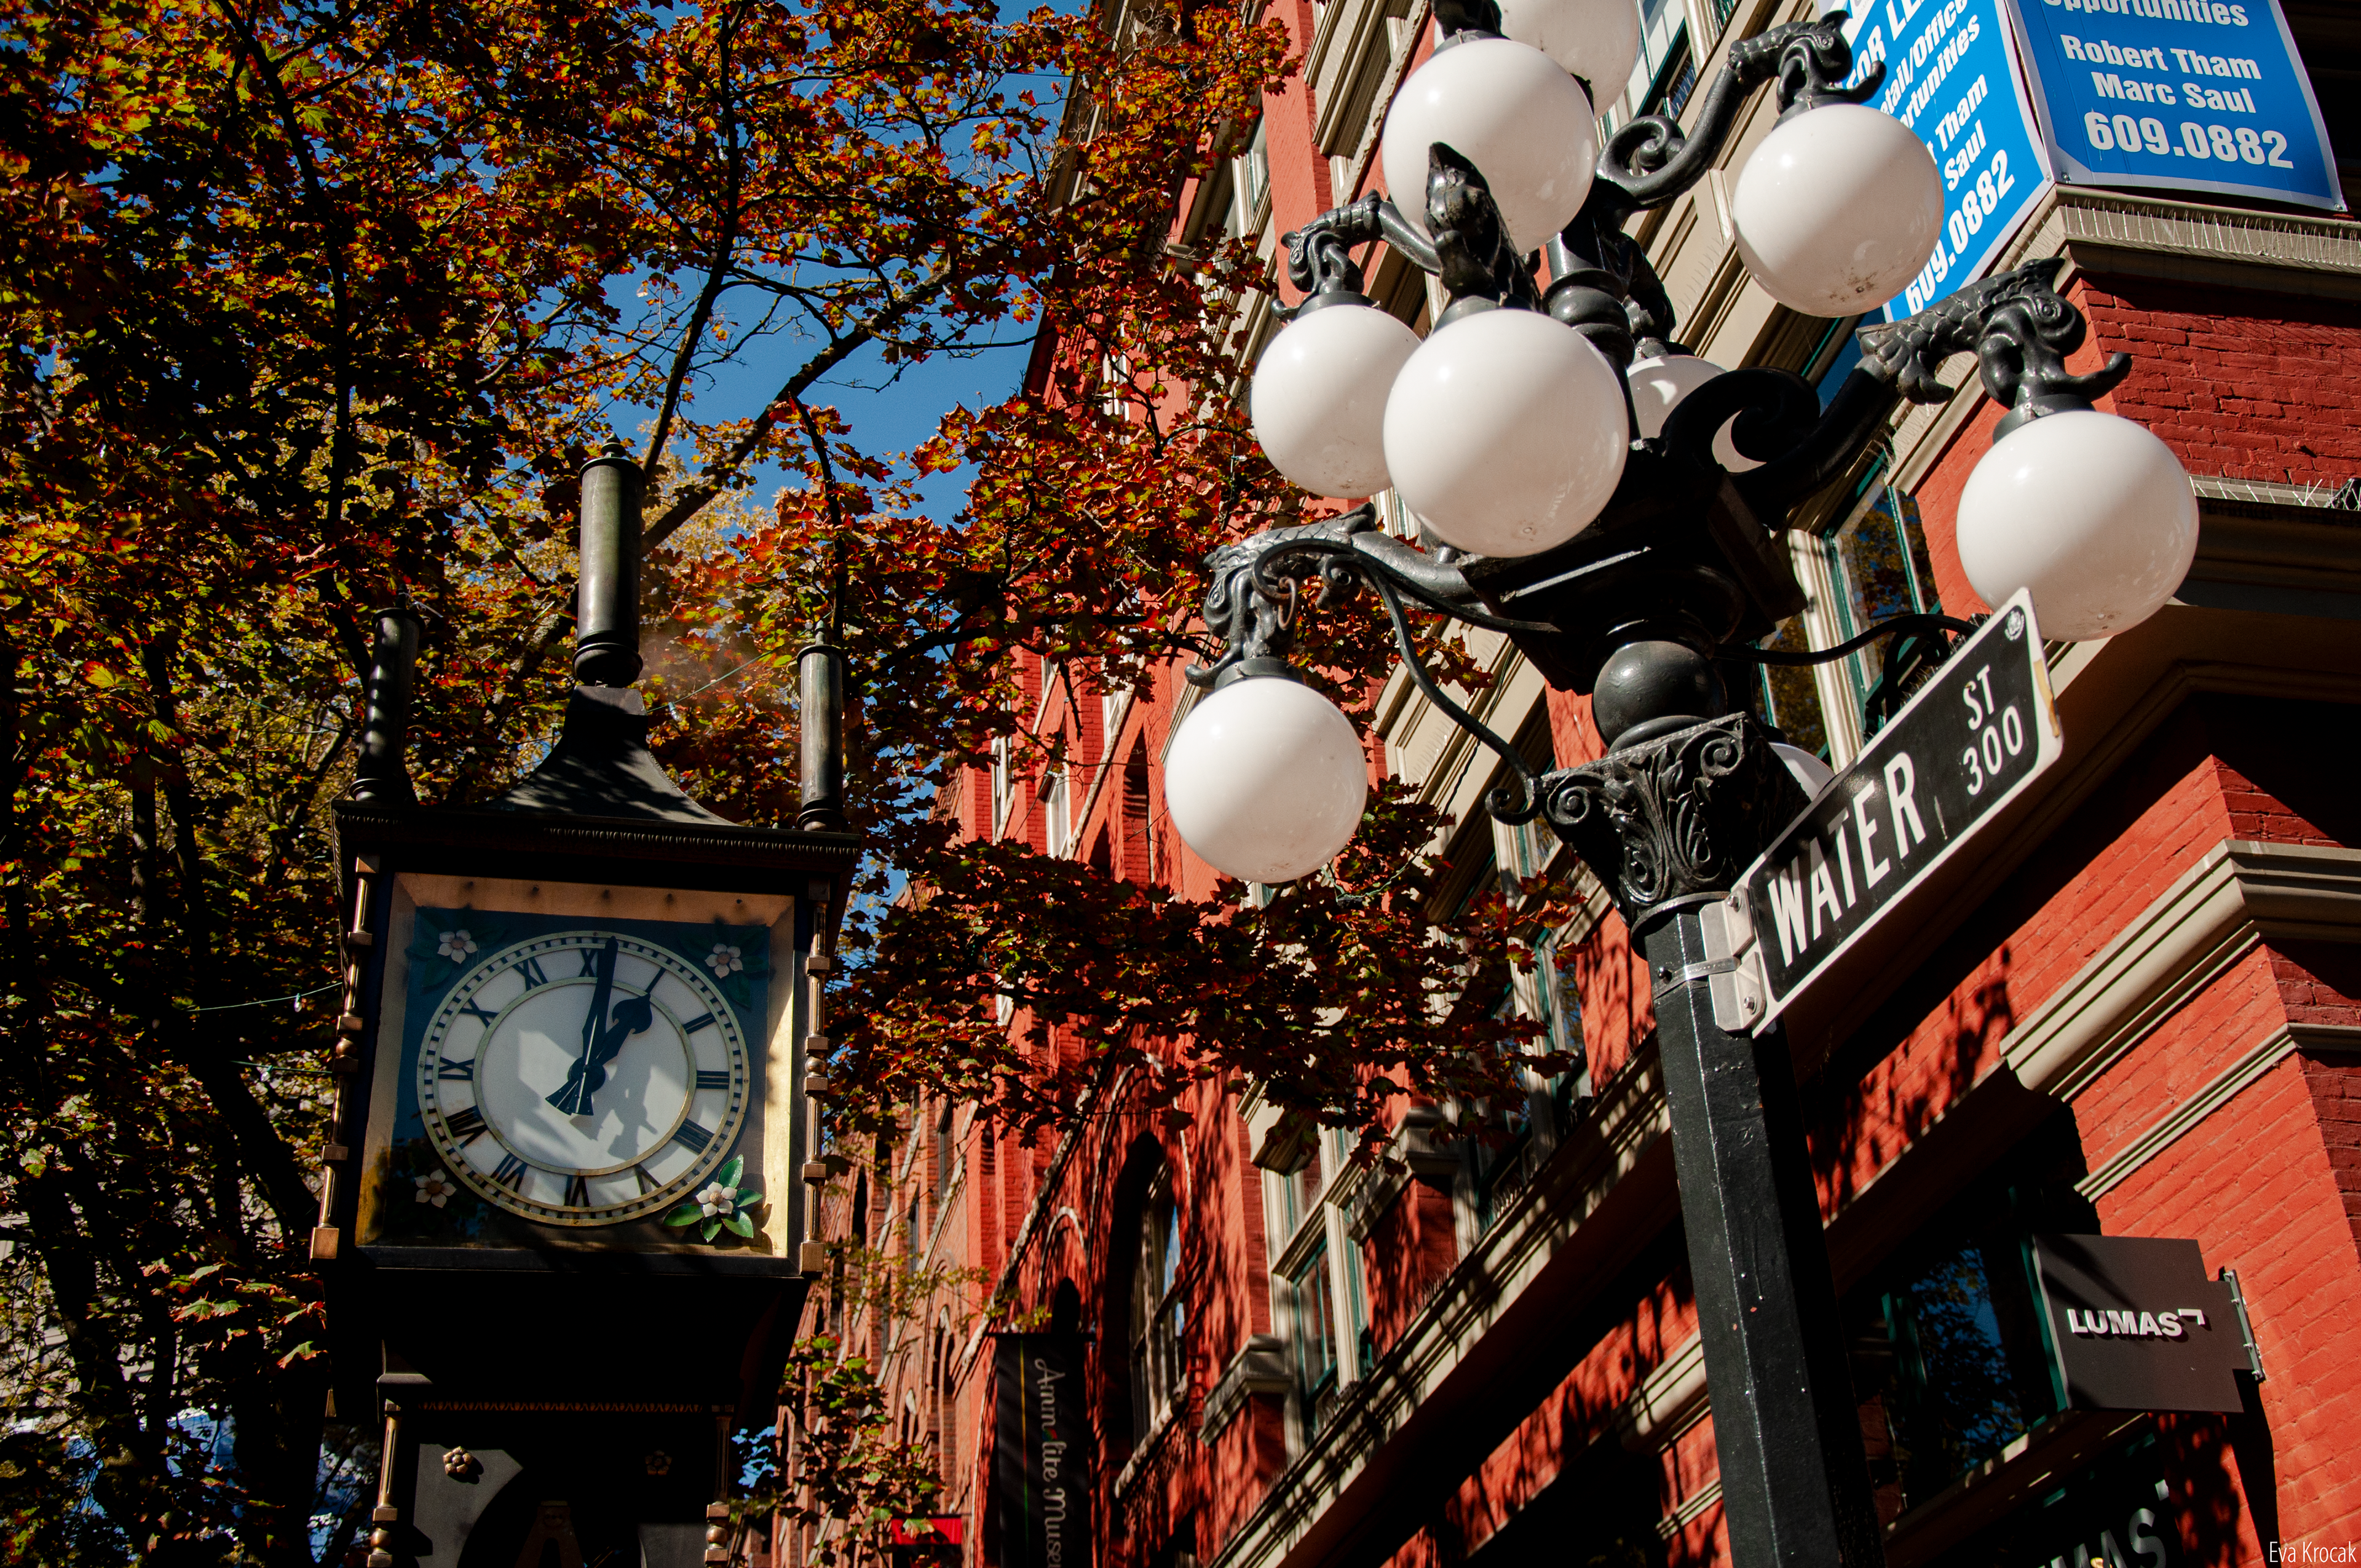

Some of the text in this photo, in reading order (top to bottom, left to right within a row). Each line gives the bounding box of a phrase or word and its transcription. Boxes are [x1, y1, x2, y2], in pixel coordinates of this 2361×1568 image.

[2060, 34, 2262, 80] Robert Tham
[1934, 74, 1988, 152] Tham
[2090, 71, 2256, 113] Marc Saul
[1944, 119, 1987, 191] Saul
[2083, 111, 2294, 169] 609.0882
[1963, 664, 1995, 731] ST
[1962, 705, 2023, 797] 300
[1767, 751, 1926, 967] WATER
[2066, 1308, 2183, 1337] LUMAS
